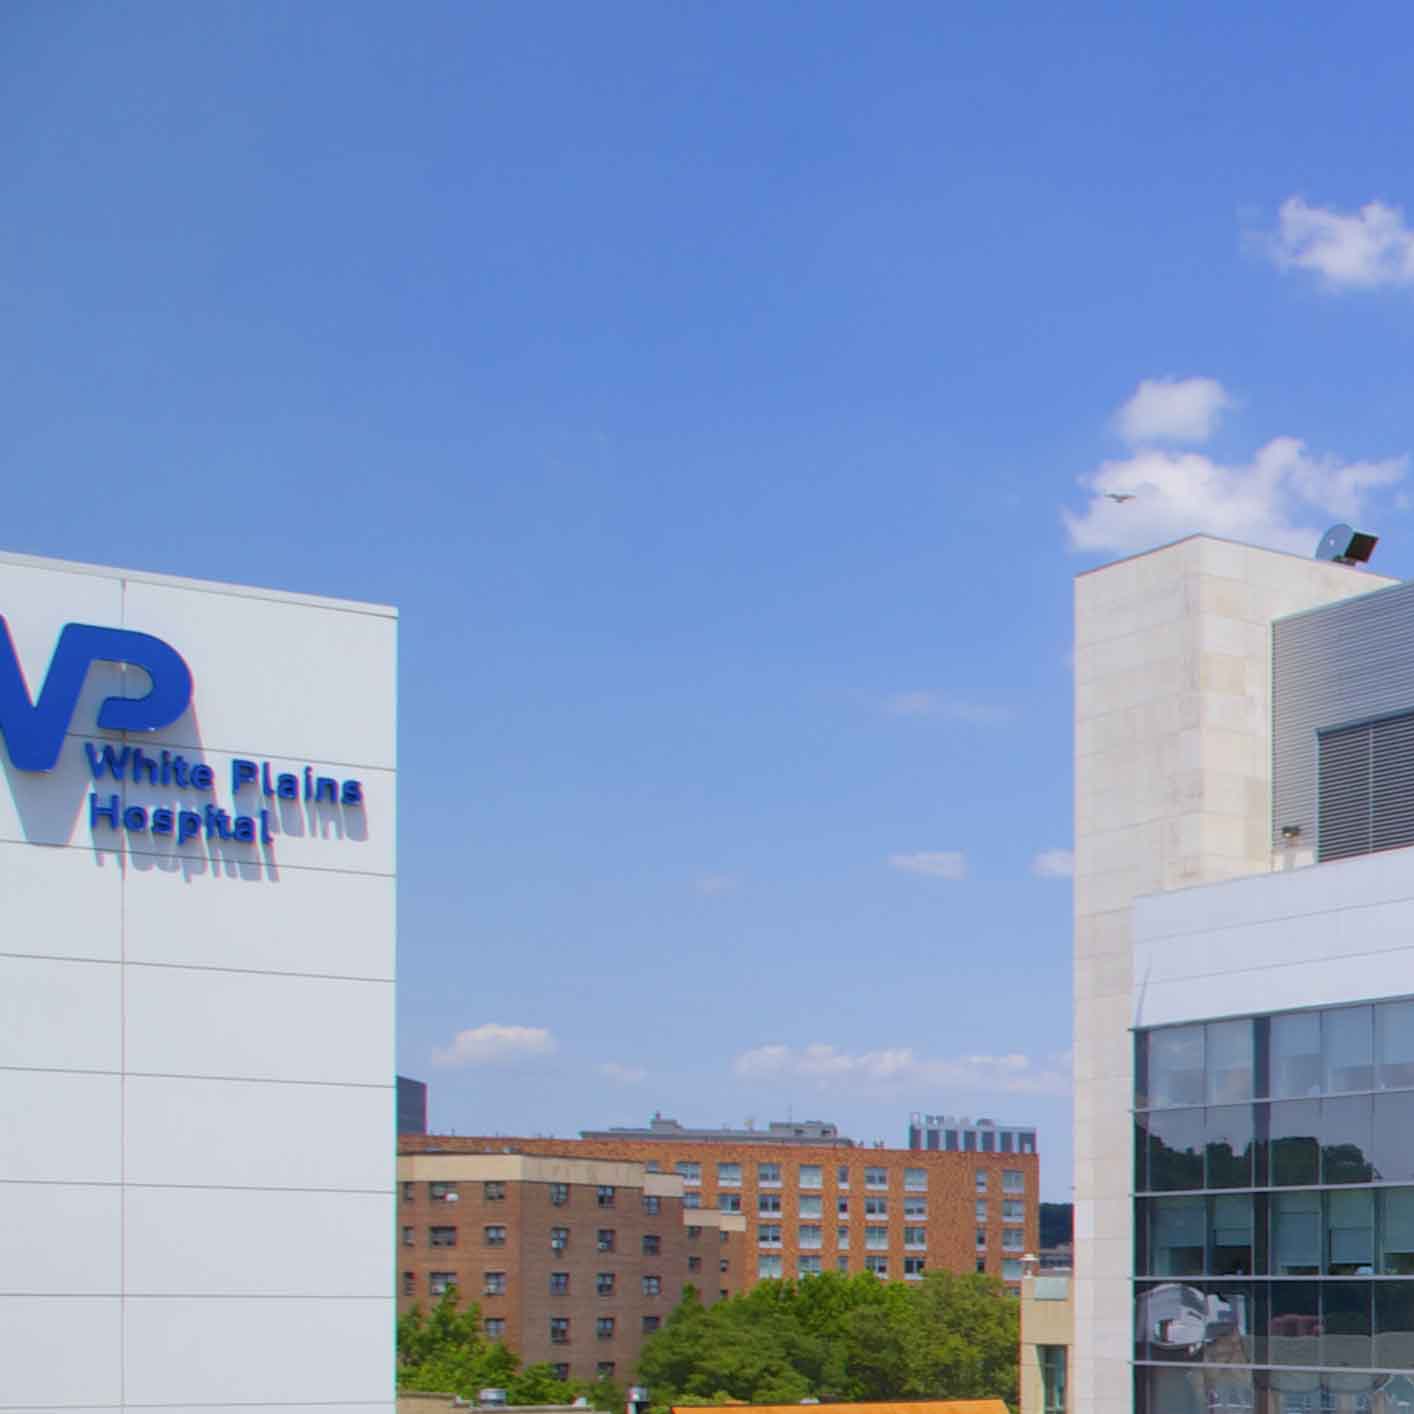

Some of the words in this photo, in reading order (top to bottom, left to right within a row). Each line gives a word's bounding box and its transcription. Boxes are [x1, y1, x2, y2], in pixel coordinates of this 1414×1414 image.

[85, 741, 215, 790] White
[231, 758, 363, 806] Plains
[88, 792, 274, 846] Hospital
